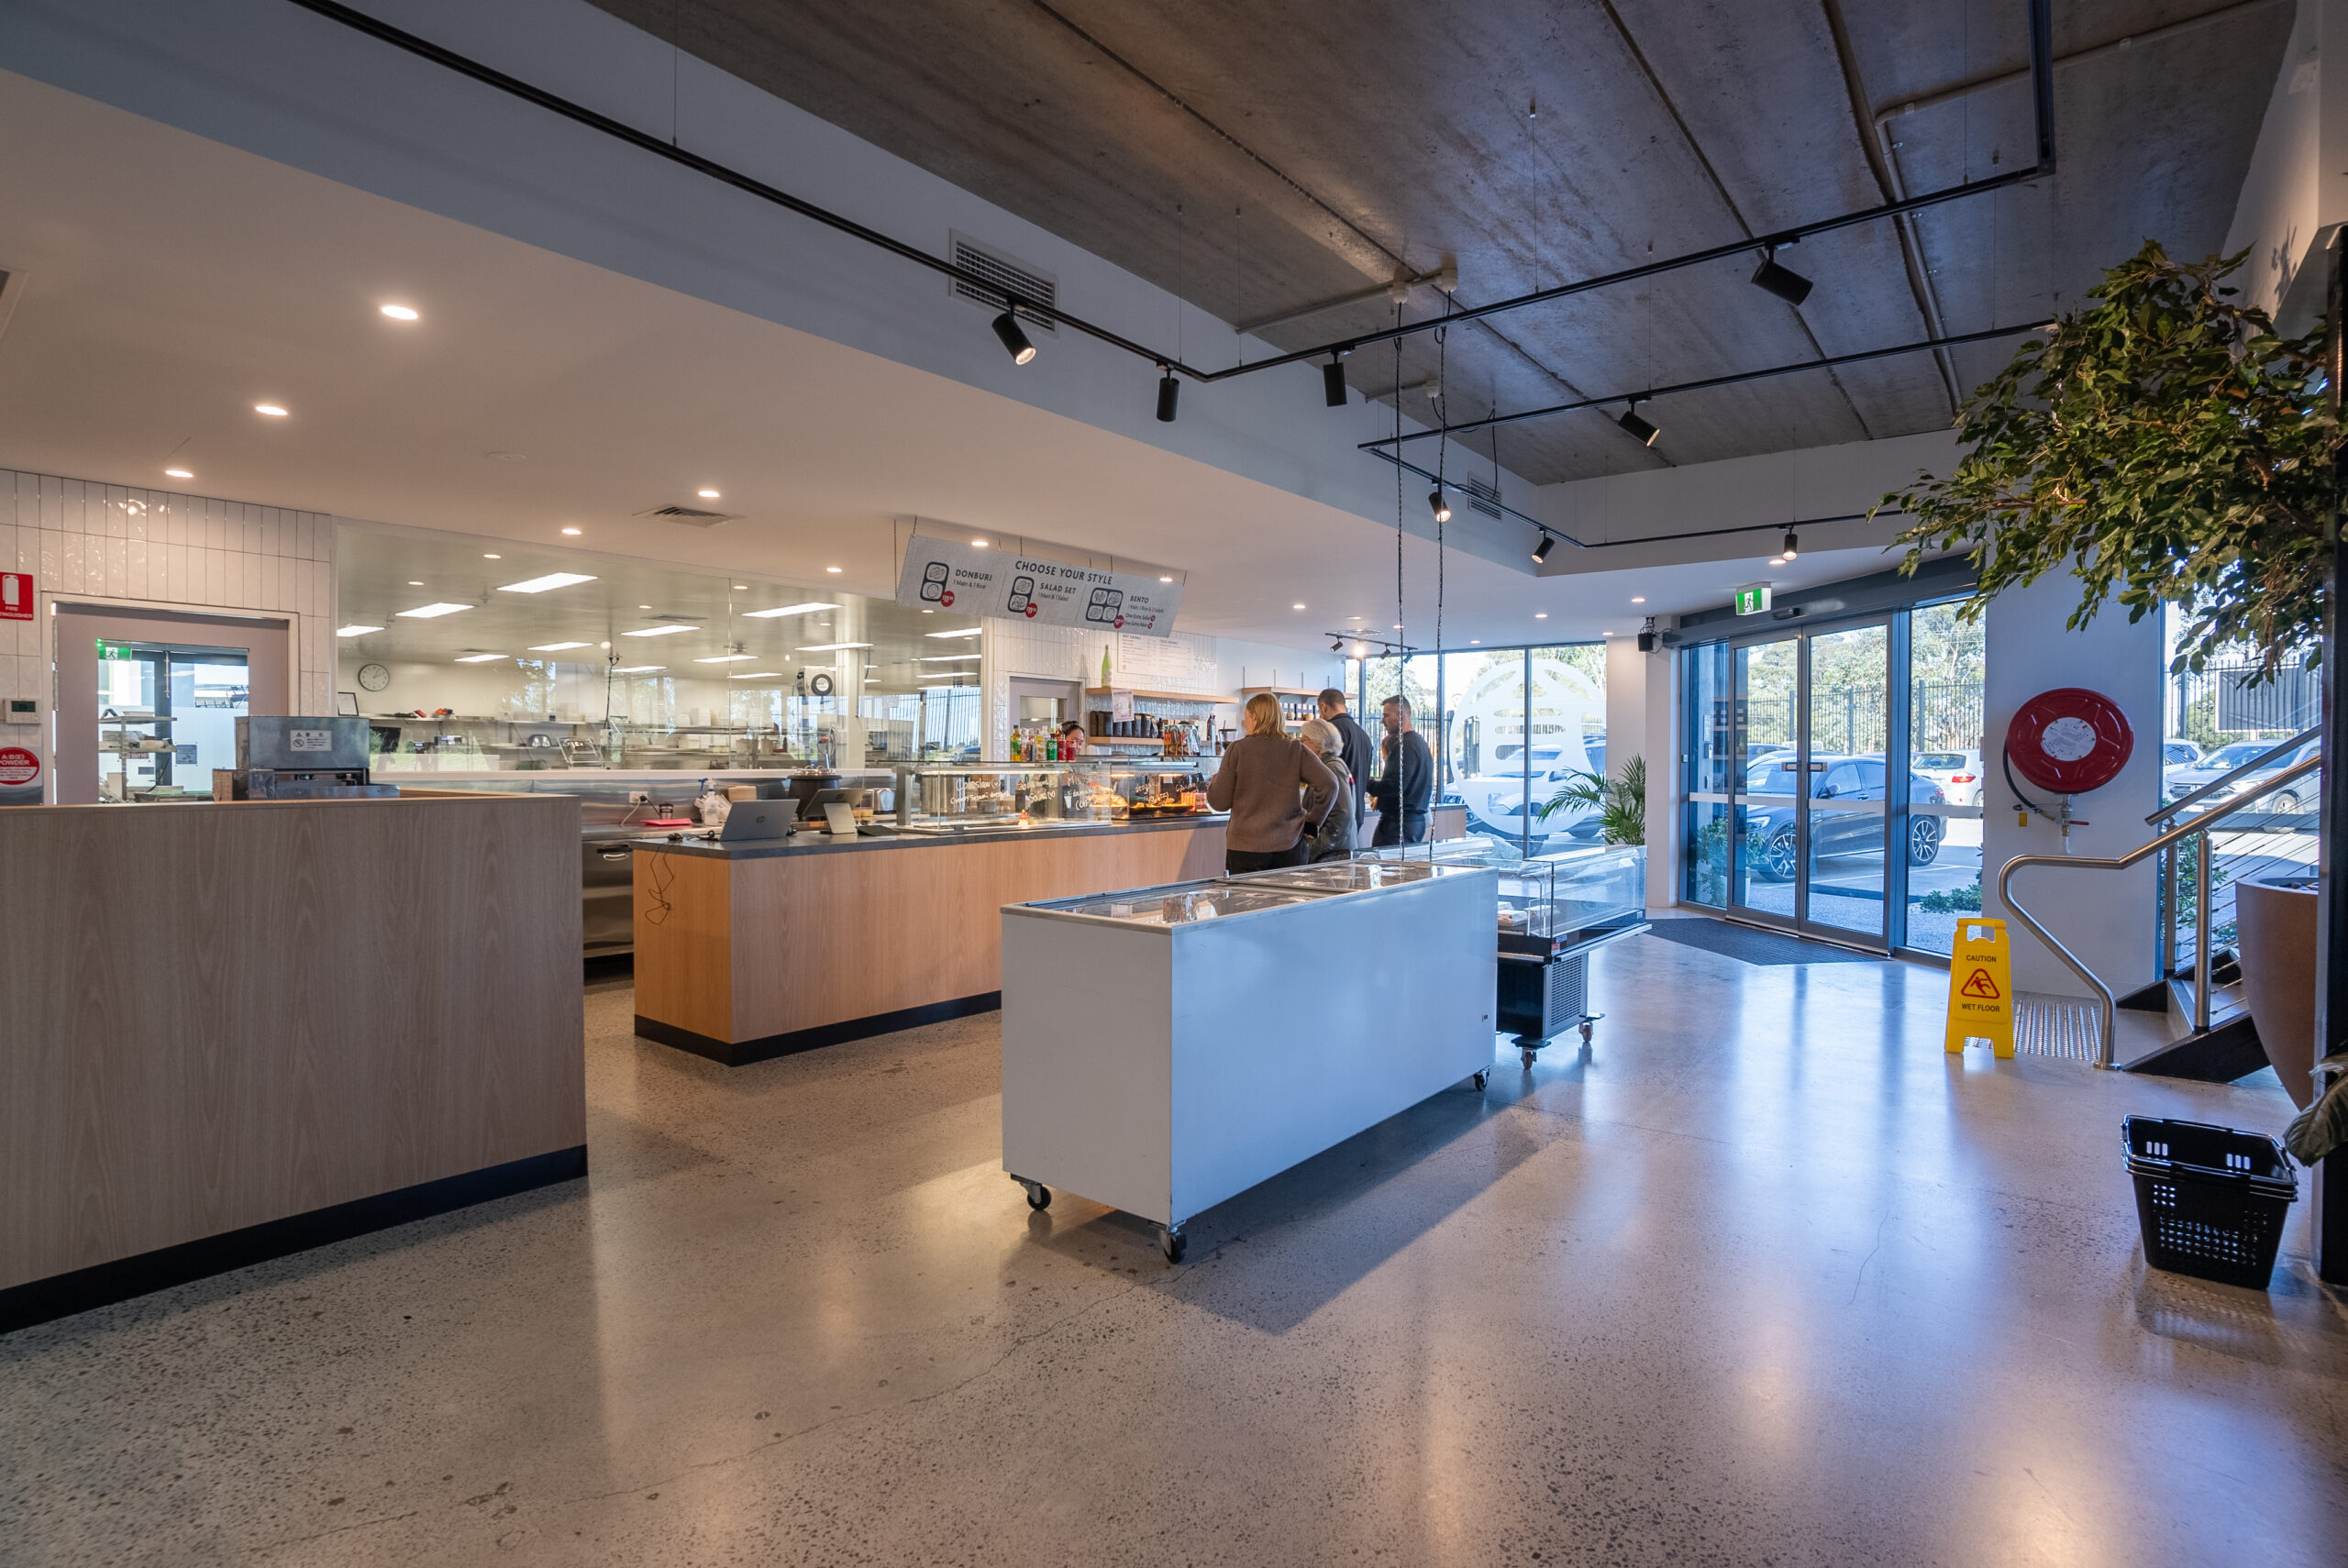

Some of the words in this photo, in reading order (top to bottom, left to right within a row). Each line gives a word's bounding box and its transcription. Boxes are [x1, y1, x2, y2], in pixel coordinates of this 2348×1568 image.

[955, 569, 992, 581] DONBURI
[1014, 560, 1057, 576] CHOOSE
[1059, 568, 1085, 580] YOUR
[1087, 573, 1113, 585] STYLE
[1040, 582, 1063, 592] SALAD
[1064, 586, 1077, 594] SET
[1130, 595, 1149, 603] BENTO
[1966, 955, 1997, 963] CAUTION
[1977, 1004, 2000, 1012] FLOOR
